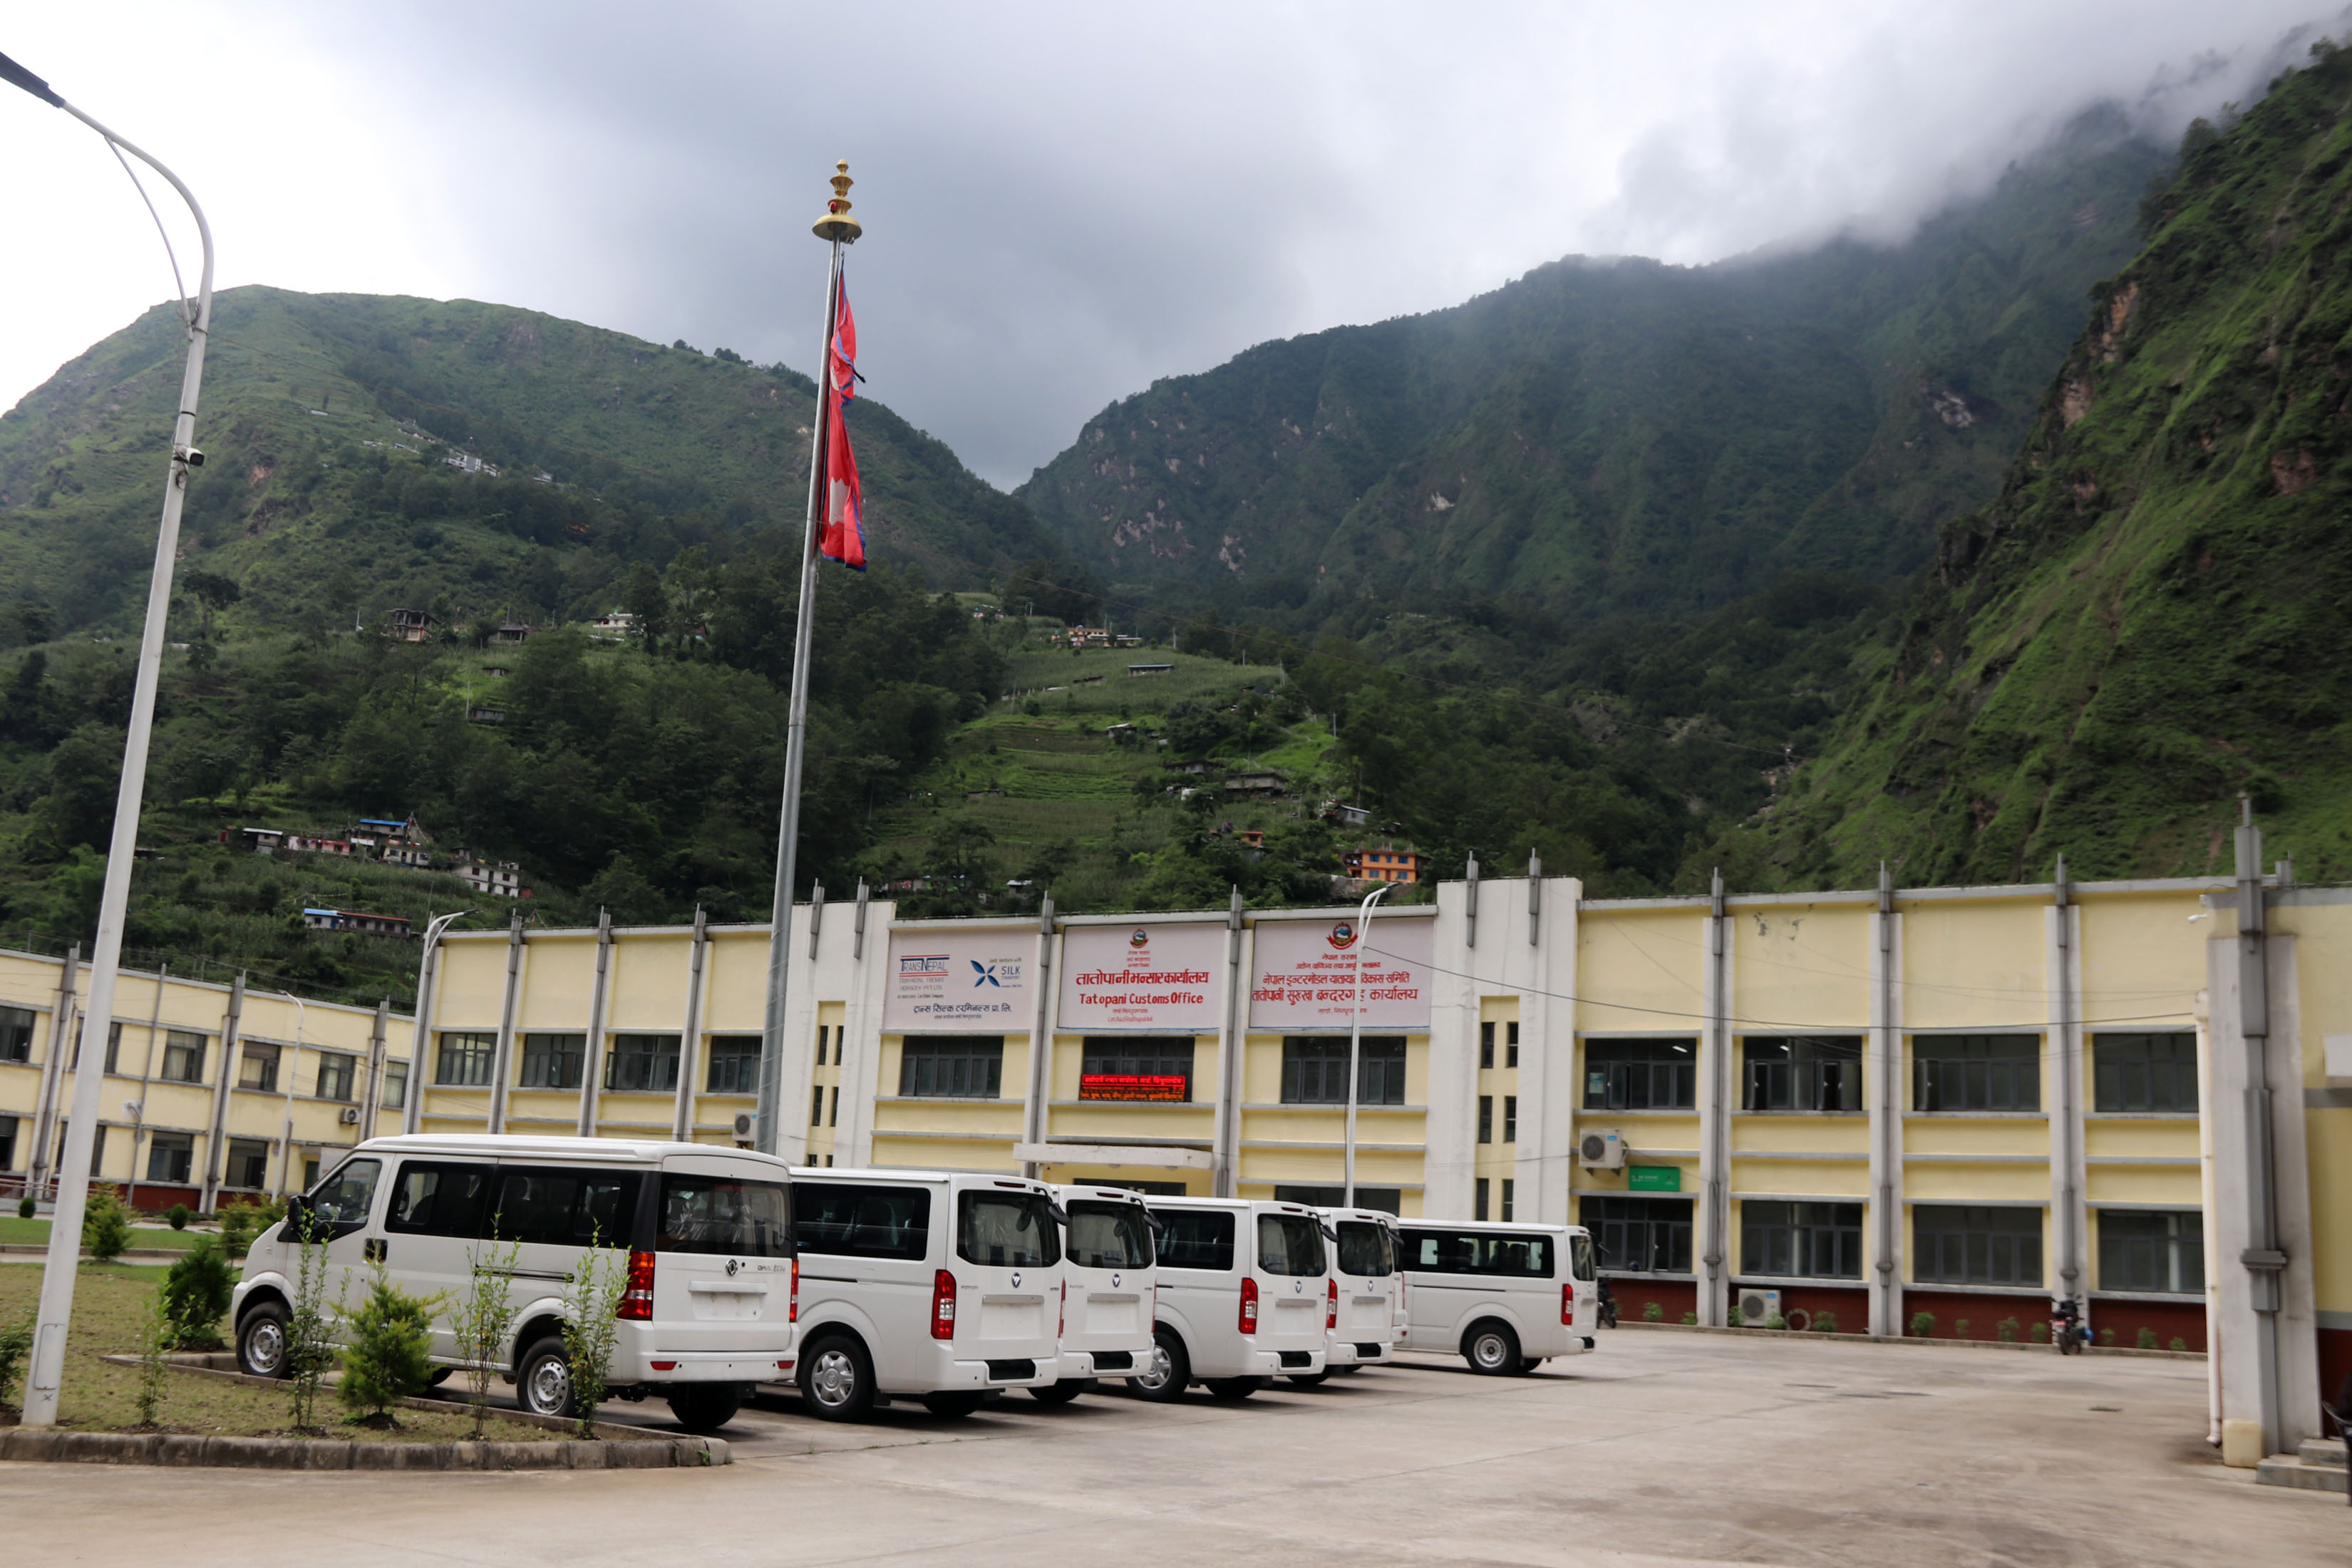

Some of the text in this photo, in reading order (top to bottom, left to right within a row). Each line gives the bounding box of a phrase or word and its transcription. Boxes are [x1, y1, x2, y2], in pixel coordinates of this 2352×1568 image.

[1001, 965, 1021, 975] SILK
[1076, 969, 1209, 985] तातोपानी भन्सार कार्यालय
[1263, 972, 1284, 985] नेपाल
[1361, 972, 1384, 984] विकास
[1386, 971, 1410, 984] समिति
[1079, 992, 1204, 1007] Tatopani Customs Office
[1252, 987, 1284, 1001] तातोपानी
[1369, 986, 1419, 1001] कार्यालय
[933, 1003, 954, 1012] सिल्क
